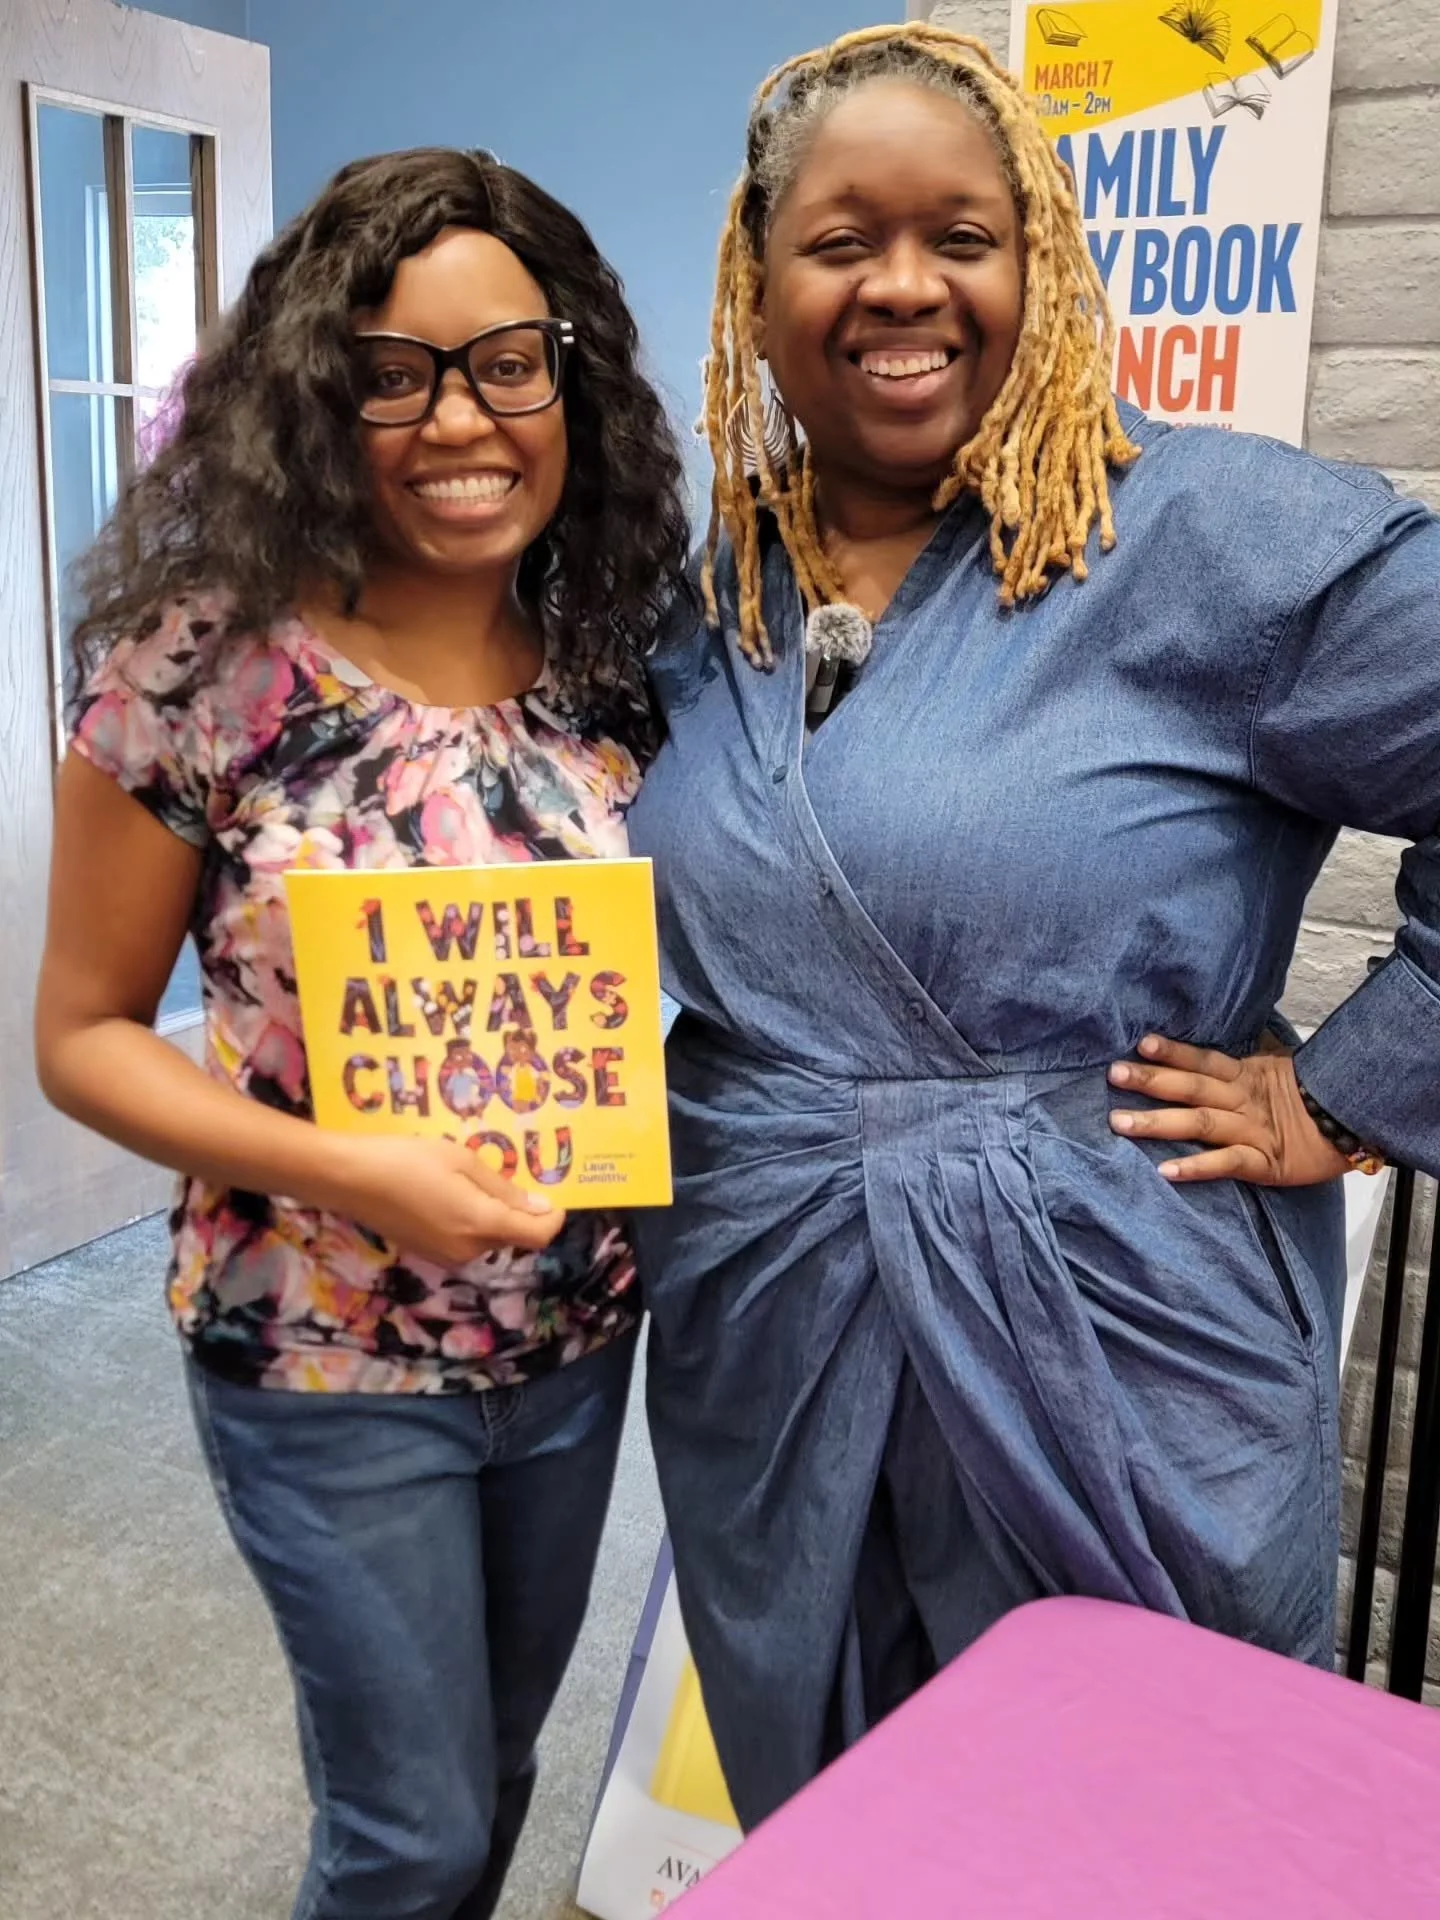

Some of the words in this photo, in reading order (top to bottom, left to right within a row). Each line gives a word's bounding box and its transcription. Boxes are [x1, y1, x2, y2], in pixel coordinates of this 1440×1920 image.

[1034, 61, 1098, 90] MARCH
[1102, 60, 1113, 87] 7
[1036, 93, 1069, 116] 0AM
[1084, 91, 1111, 114] 2PM
[1056, 125, 1226, 219] AMILY
[1129, 223, 1303, 315] BOOK
[1116, 325, 1240, 412] NCH
[356, 898, 387, 963] I
[416, 897, 590, 962] WILL
[339, 970, 630, 1037] ALWAYS
[341, 1028, 627, 1121] CHOOSE
[442, 1126, 573, 1185] OU
[656, 1855, 700, 1888] AVA
